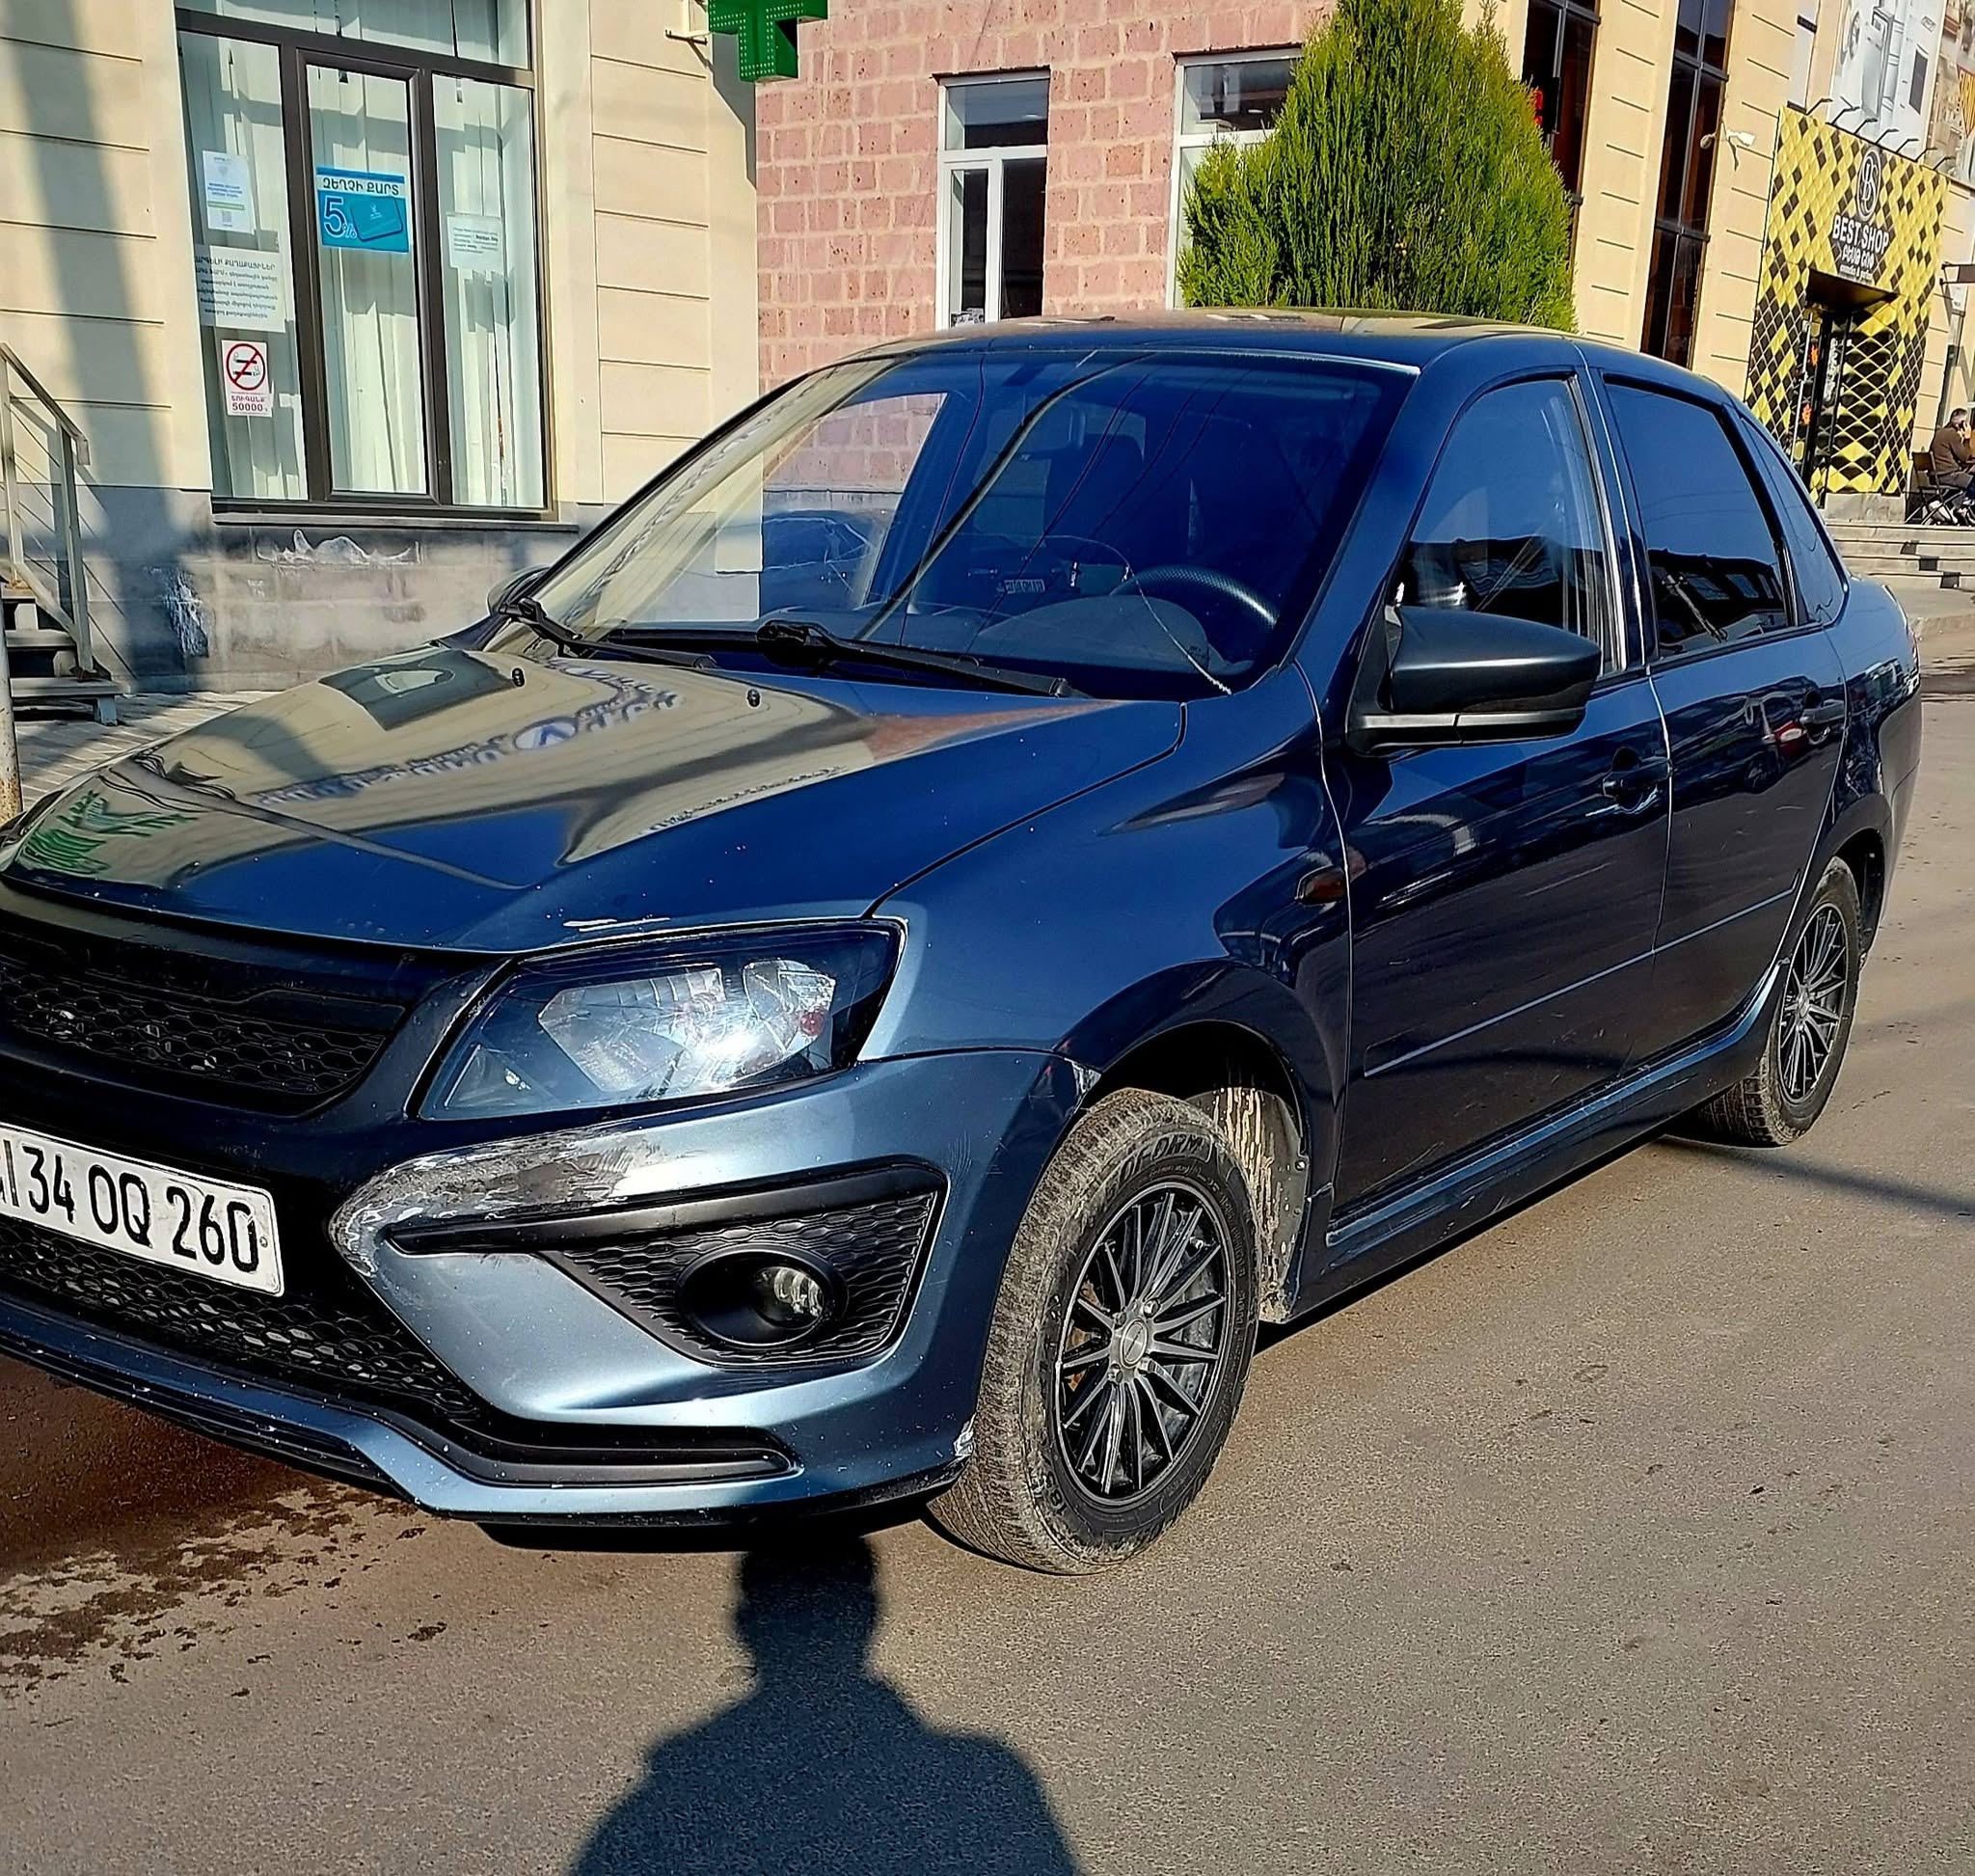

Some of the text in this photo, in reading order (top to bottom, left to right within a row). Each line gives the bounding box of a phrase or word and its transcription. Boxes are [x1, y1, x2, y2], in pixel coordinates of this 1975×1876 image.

[322, 177, 399, 196] ԶԵՂՉԻ ՔԱՐՏ
[323, 195, 358, 239] 5%
[1832, 213, 1890, 255] BEST SHOP
[231, 401, 263, 413] 50000
[21, 1144, 259, 1274] 34 OQ 260
